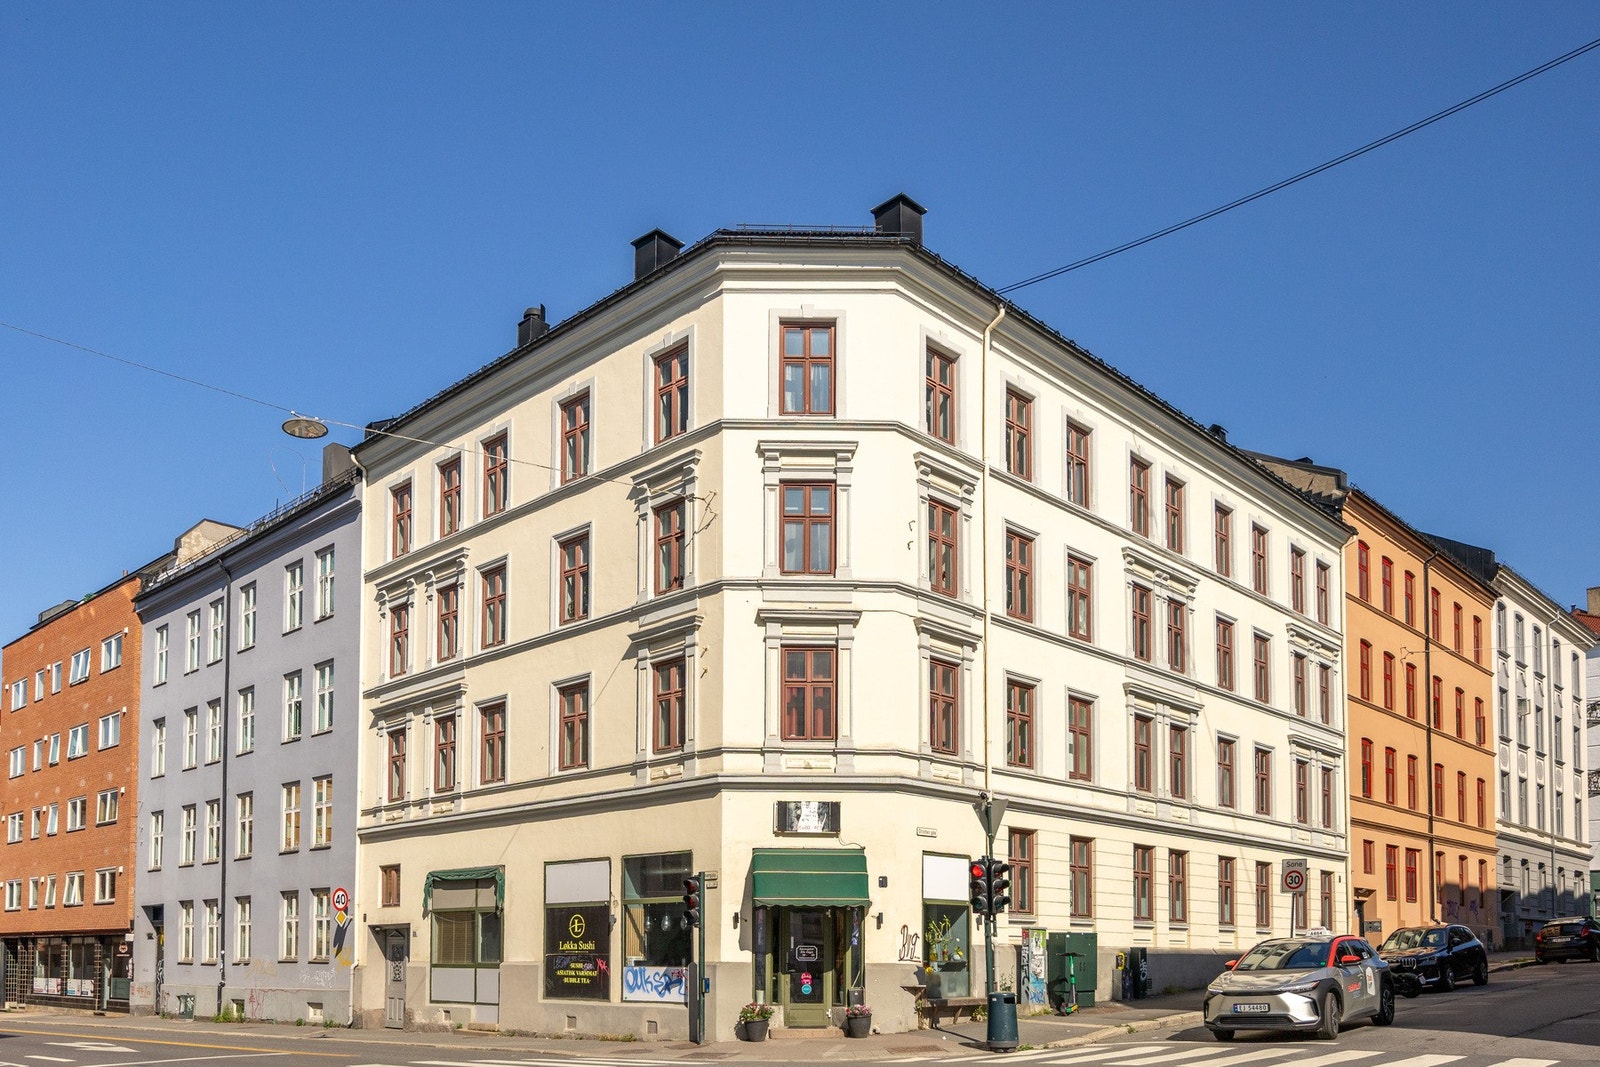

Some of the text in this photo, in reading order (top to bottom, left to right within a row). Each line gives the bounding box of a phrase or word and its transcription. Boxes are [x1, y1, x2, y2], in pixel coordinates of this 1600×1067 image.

[1288, 875, 1300, 885] 30
[335, 893, 346, 905] 40
[578, 940, 596, 950] Sushi
